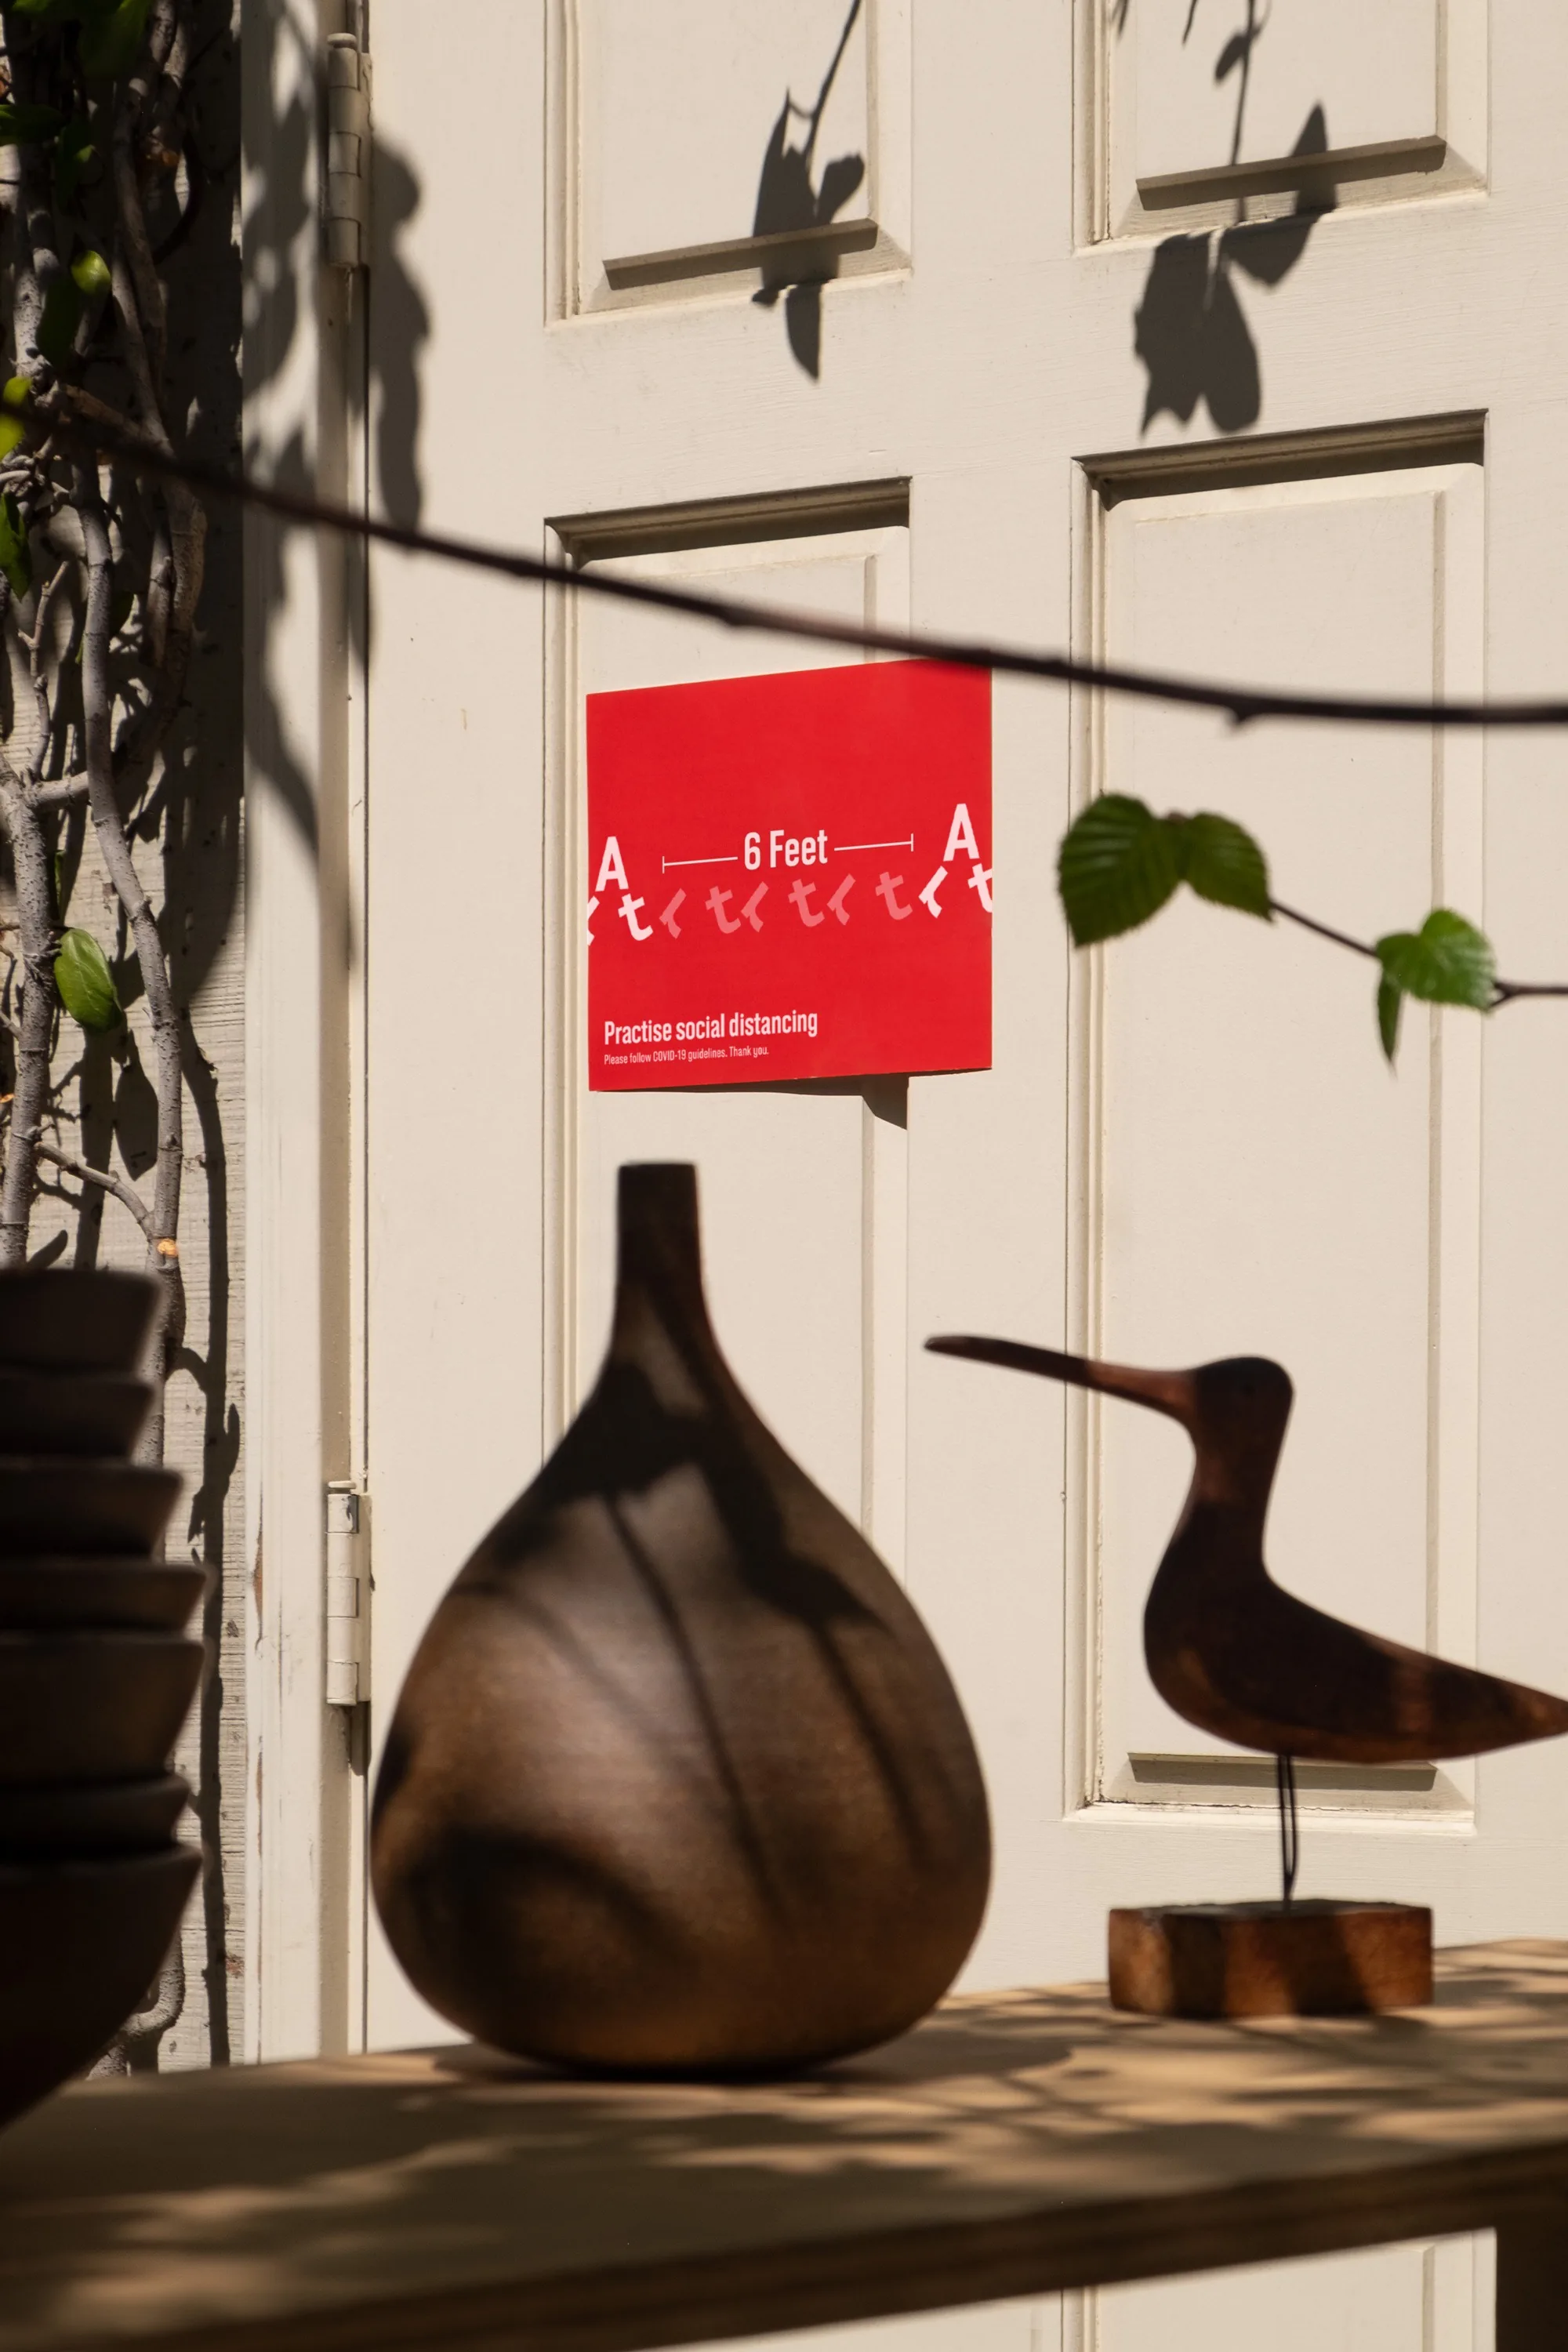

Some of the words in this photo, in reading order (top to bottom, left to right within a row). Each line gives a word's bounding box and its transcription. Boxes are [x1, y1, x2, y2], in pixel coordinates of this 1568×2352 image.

[745, 832, 761, 871] 6
[770, 829, 829, 868] Feet
[604, 1020, 673, 1045] Practise
[676, 1013, 725, 1041] social
[729, 1010, 818, 1037] distancing
[604, 1053, 628, 1065] Please
[630, 1051, 652, 1063] follow
[653, 1049, 687, 1062] COVID-19
[688, 1047, 728, 1062] guidelines.
[729, 1045, 752, 1057] Thank
[753, 1047, 769, 1058] you.
